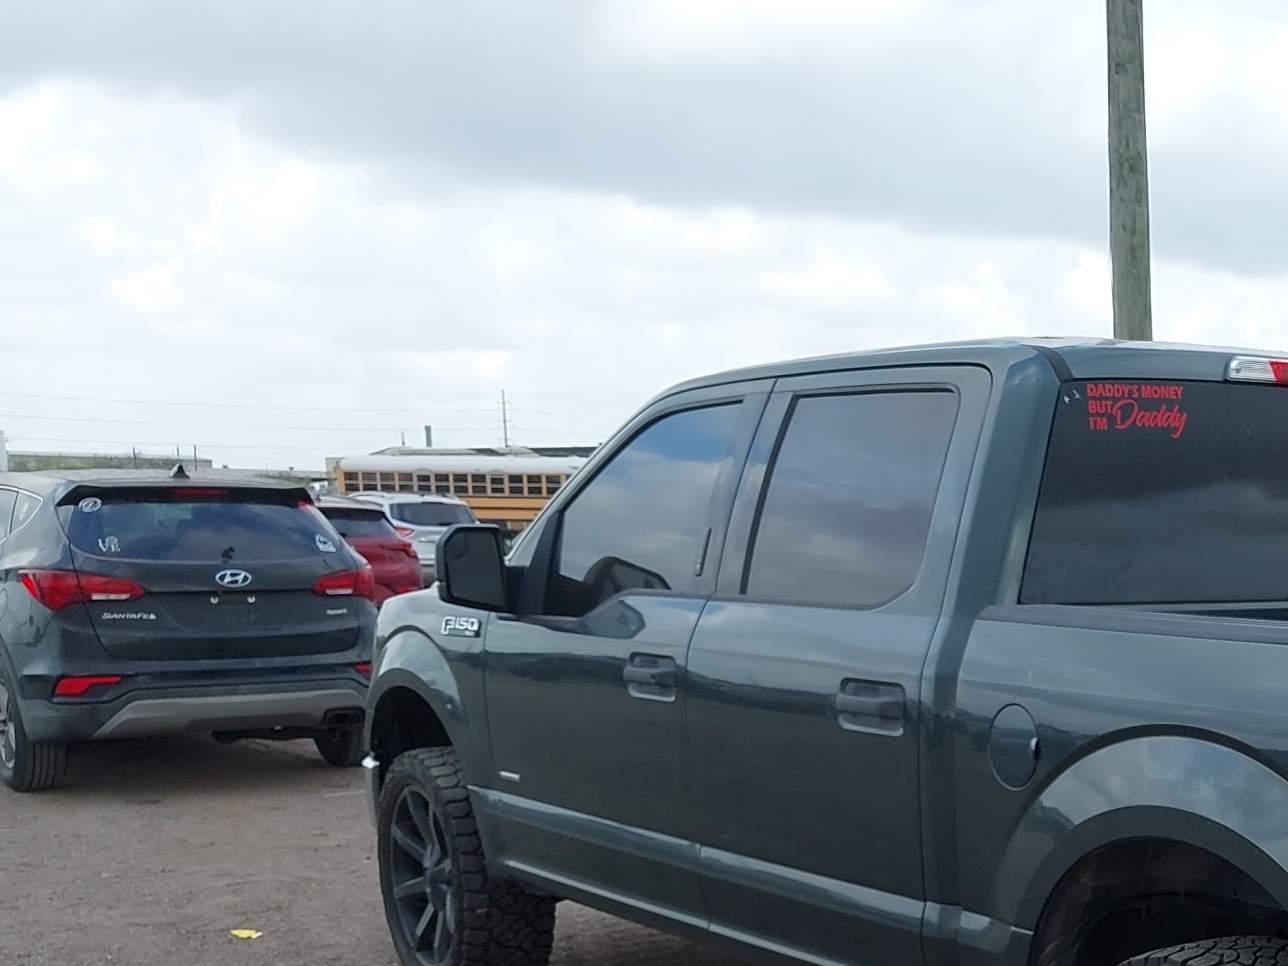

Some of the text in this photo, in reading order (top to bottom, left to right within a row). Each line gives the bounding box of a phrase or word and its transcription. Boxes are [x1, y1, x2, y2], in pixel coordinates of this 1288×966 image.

[1086, 384, 1184, 399] DADDY'S MONEY
[1088, 400, 1113, 414] BUT
[1089, 416, 1108, 430] I'M
[1112, 399, 1188, 439] Daddy
